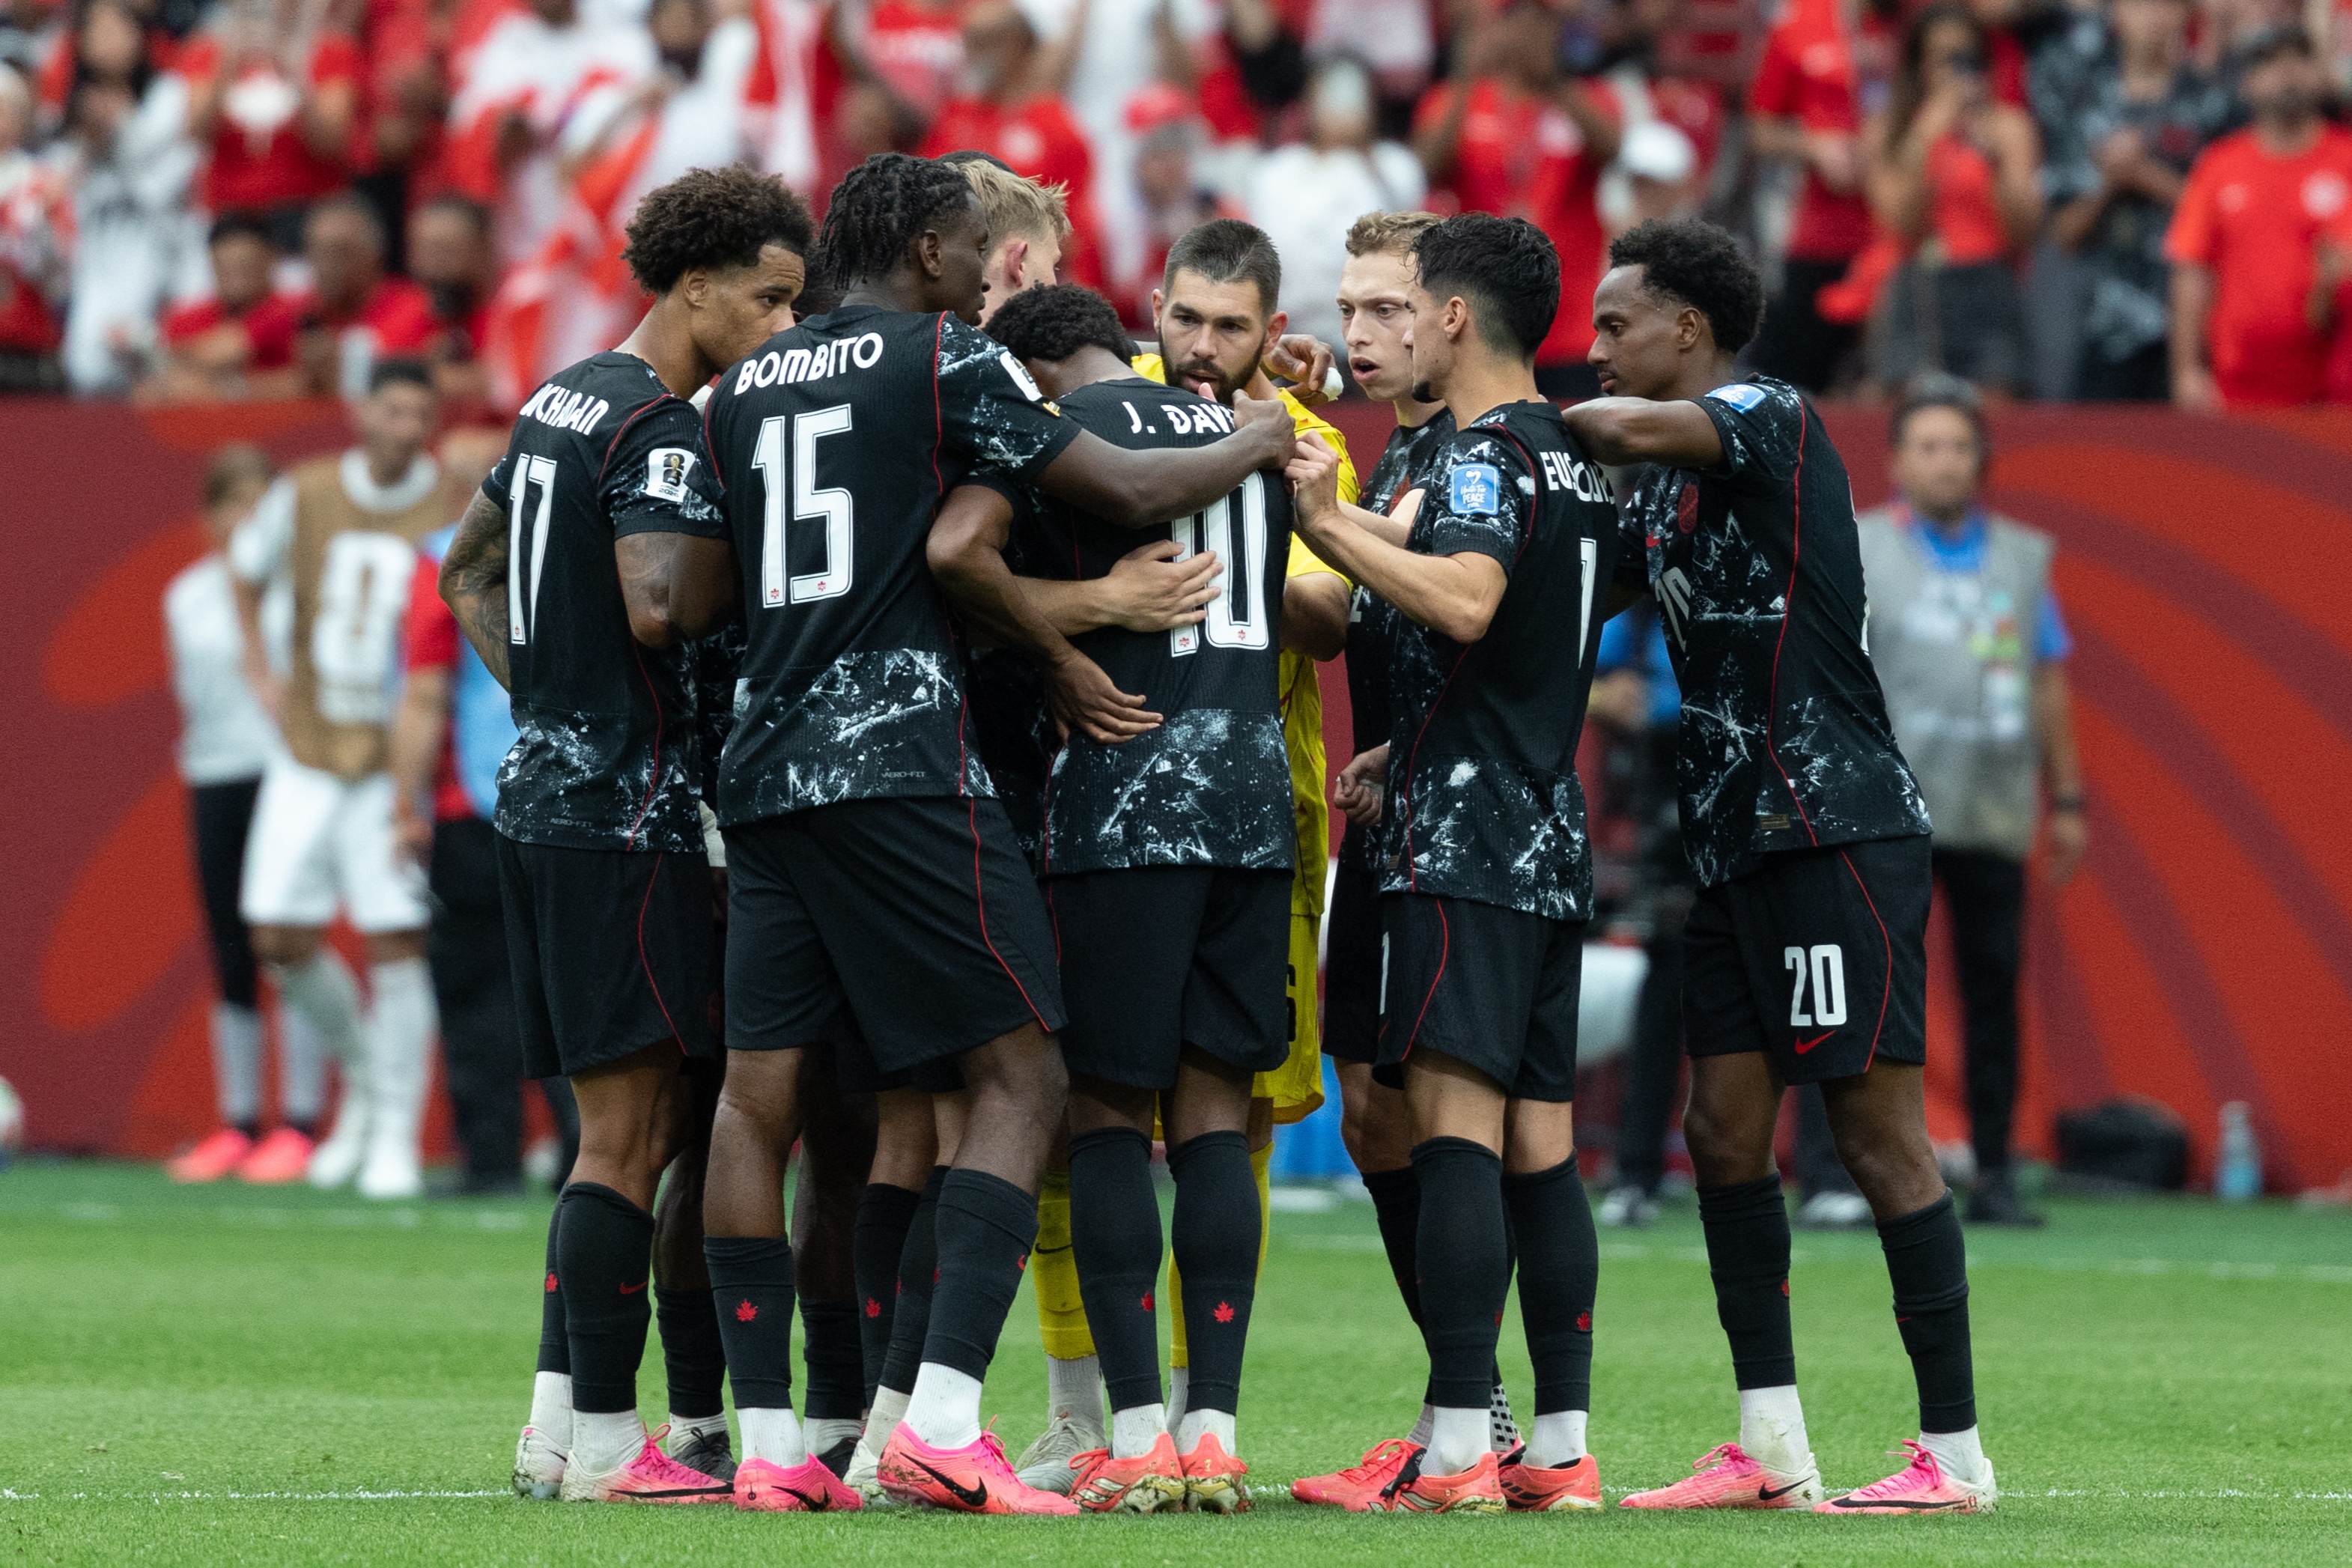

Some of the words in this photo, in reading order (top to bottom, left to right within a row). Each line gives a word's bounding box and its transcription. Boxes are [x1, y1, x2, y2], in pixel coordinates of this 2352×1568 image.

[735, 332, 884, 396] BOMBITO
[508, 452, 558, 645] 17
[751, 403, 853, 609] 15
[1171, 470, 1268, 657] 10
[1784, 944, 1847, 1027] 20
